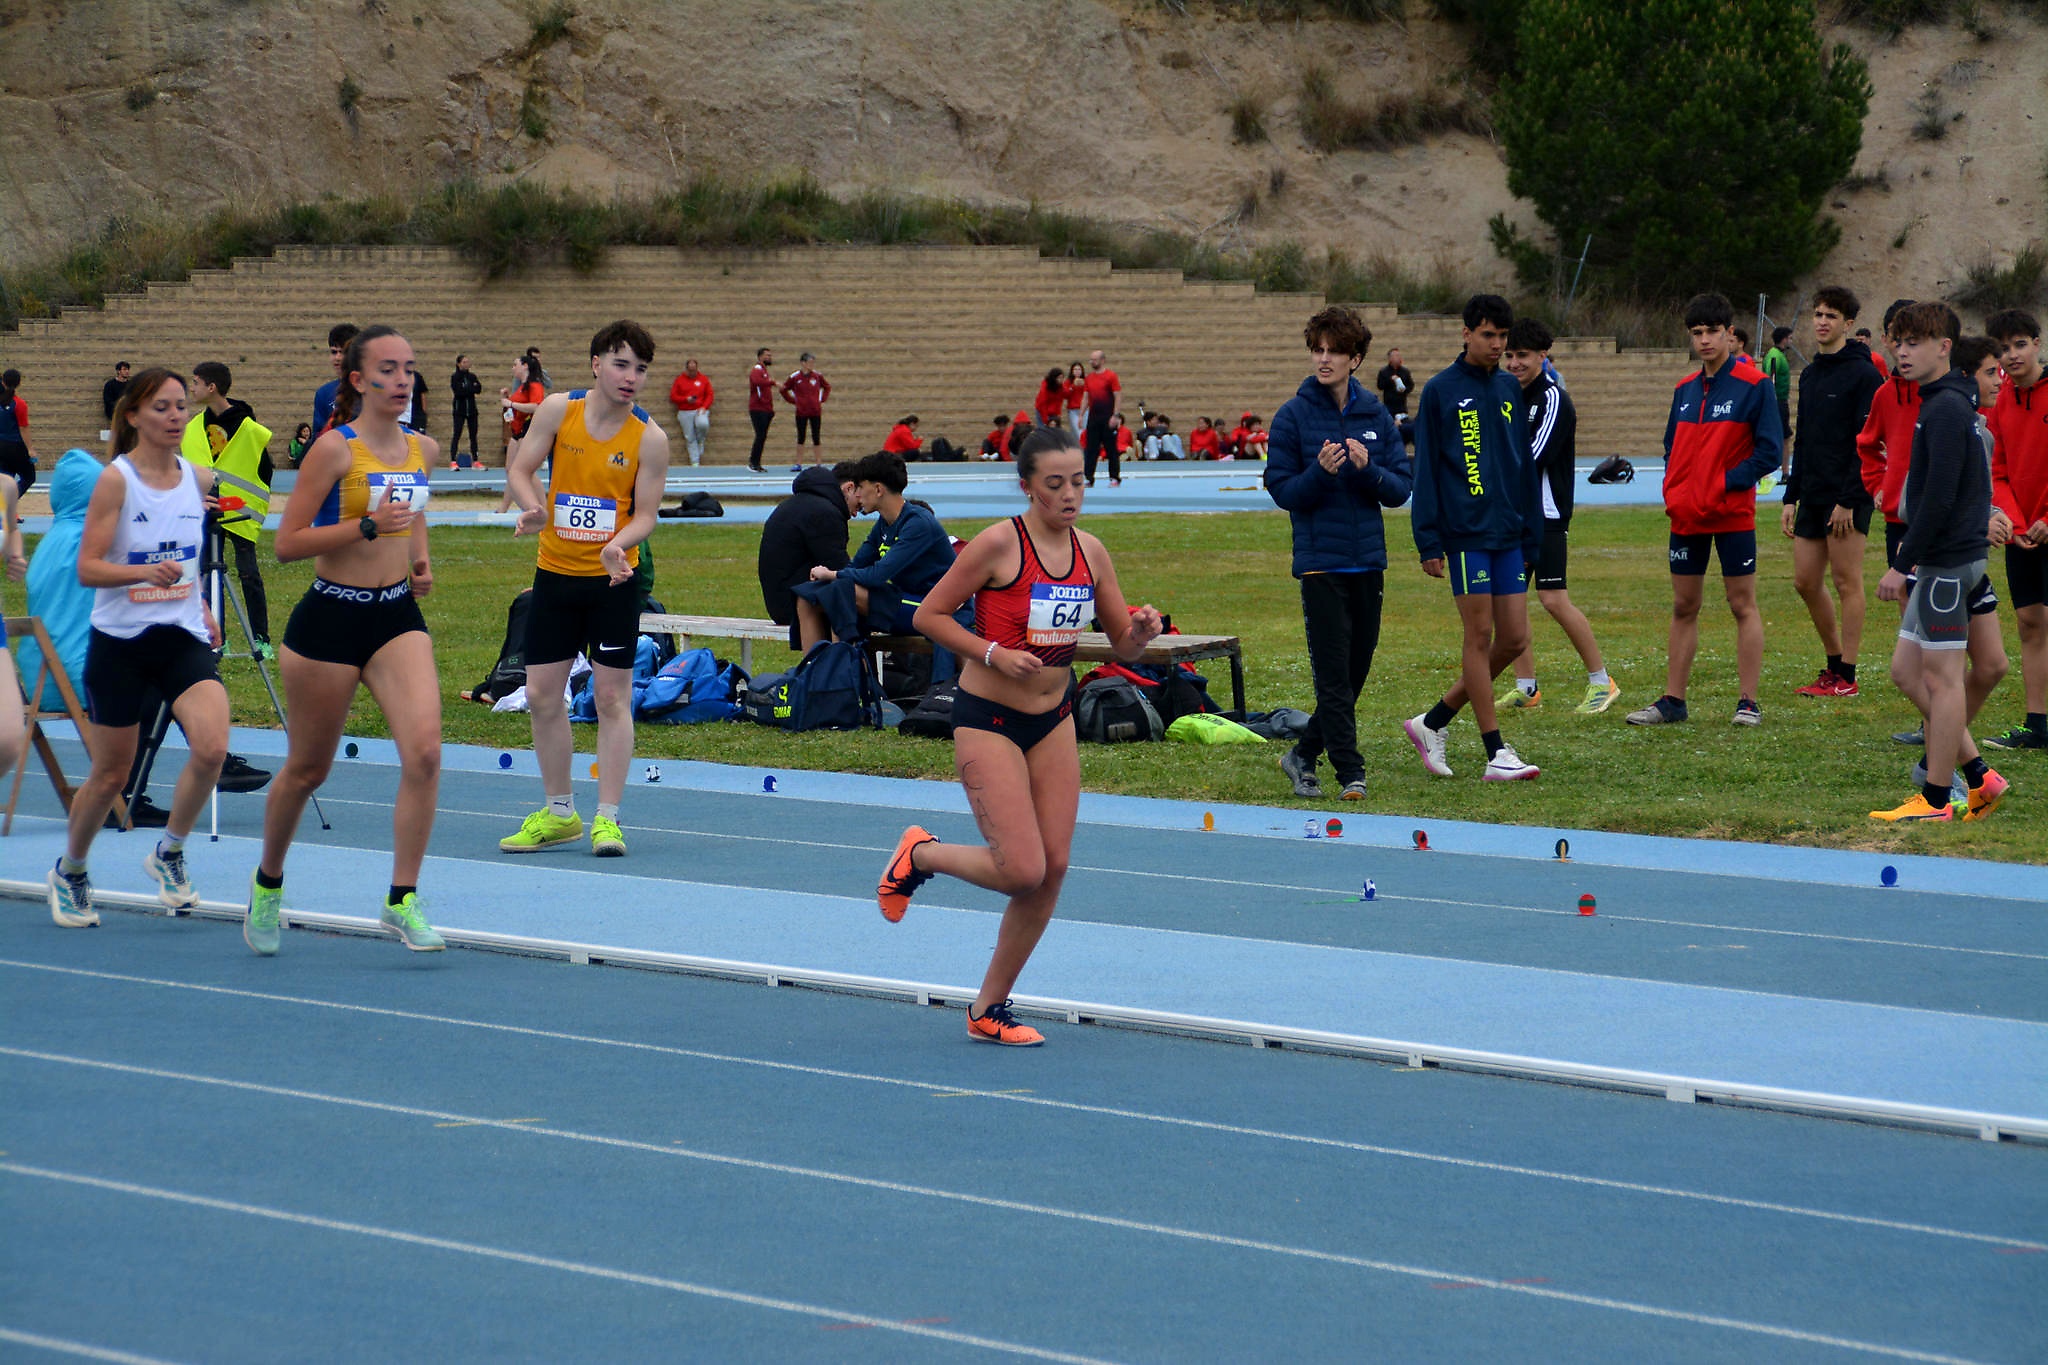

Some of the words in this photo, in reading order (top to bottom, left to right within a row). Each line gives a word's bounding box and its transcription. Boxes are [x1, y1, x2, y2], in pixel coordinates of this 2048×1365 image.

[1458, 409, 1476, 448] JUST
[1465, 452, 1484, 496] SANT
[390, 488, 413, 503] 67
[569, 508, 597, 529] 68
[556, 528, 609, 541] mutuacat
[322, 585, 374, 602] PRO
[1051, 602, 1082, 628] 64
